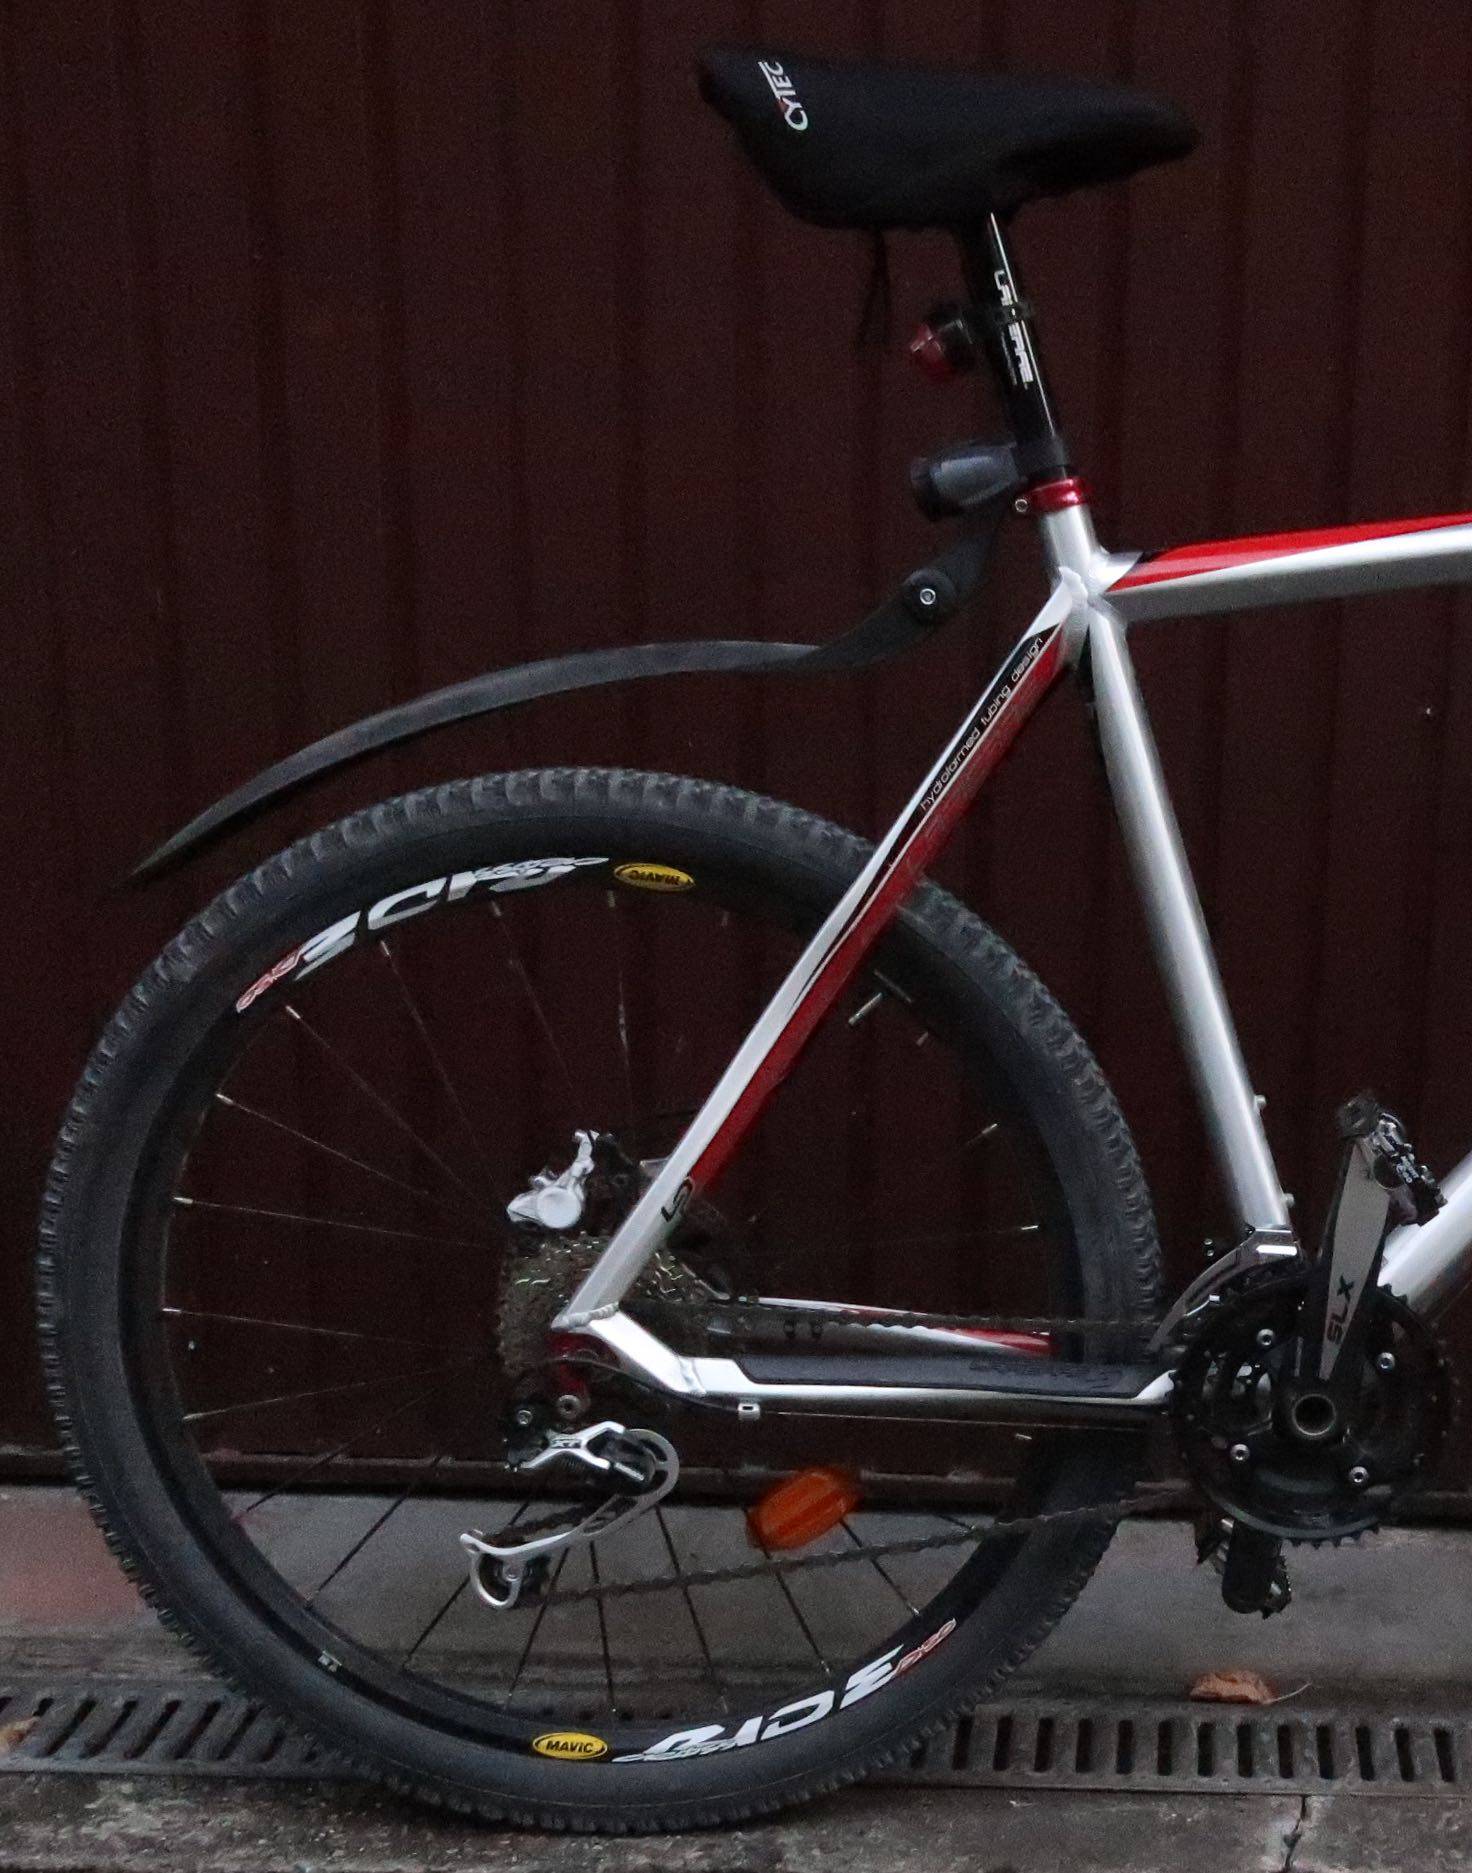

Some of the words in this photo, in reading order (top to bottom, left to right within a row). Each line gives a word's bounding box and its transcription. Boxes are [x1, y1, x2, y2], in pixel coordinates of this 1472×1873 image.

[758, 60, 809, 131] CYTEC
[632, 869, 681, 884] MAVIC
[1328, 1276, 1354, 1344] SLX
[643, 1644, 904, 1757] RIDE
[546, 1739, 594, 1754] MAVIC
